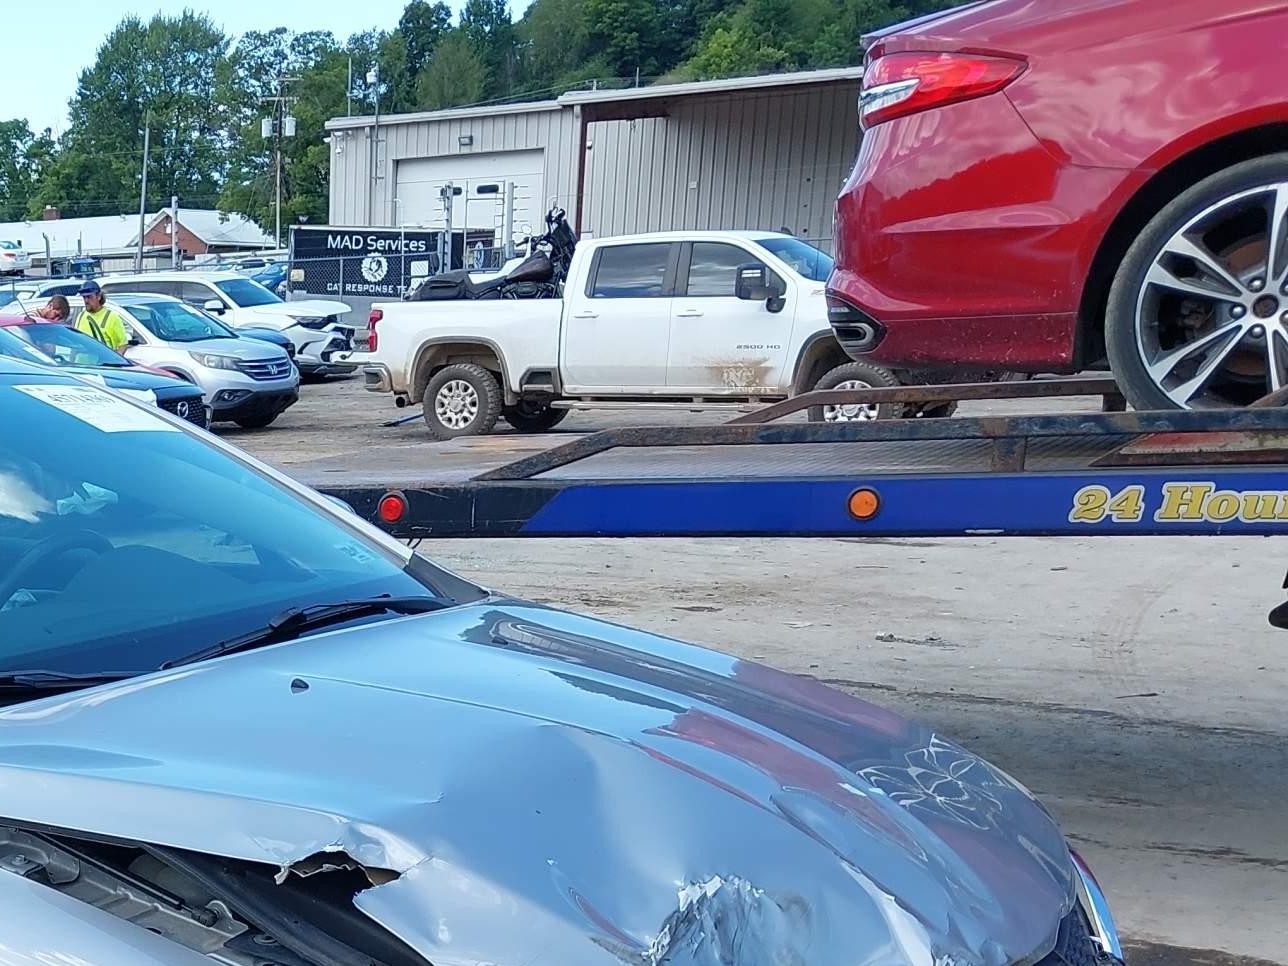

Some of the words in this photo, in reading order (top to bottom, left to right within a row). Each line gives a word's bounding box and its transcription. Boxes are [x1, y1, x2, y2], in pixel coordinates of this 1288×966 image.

[327, 234, 364, 250] MAD
[366, 235, 426, 251] Services
[345, 283, 394, 293] RESPONSE
[1071, 486, 1143, 522] 24
